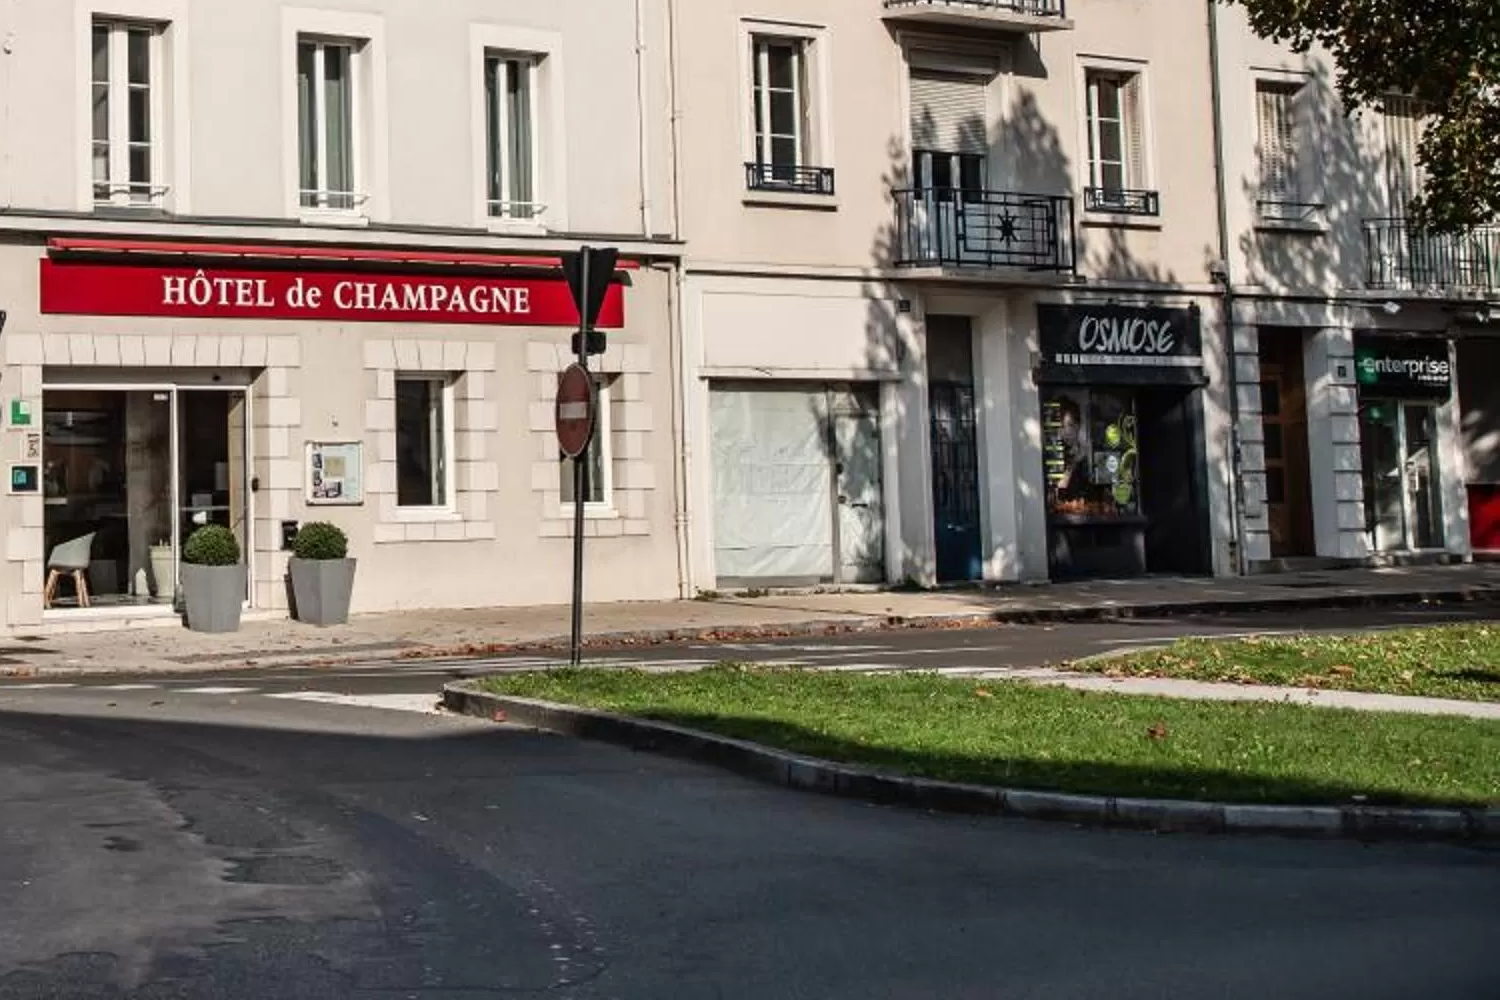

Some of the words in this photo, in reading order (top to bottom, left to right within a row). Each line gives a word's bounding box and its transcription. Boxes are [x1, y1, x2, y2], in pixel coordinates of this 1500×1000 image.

[161, 269, 275, 307] HÔTEL
[286, 278, 322, 309] de
[333, 280, 531, 314] CHAMPAGNE
[1078, 315, 1176, 354] OSMOSE
[1357, 355, 1449, 379] enterprise
